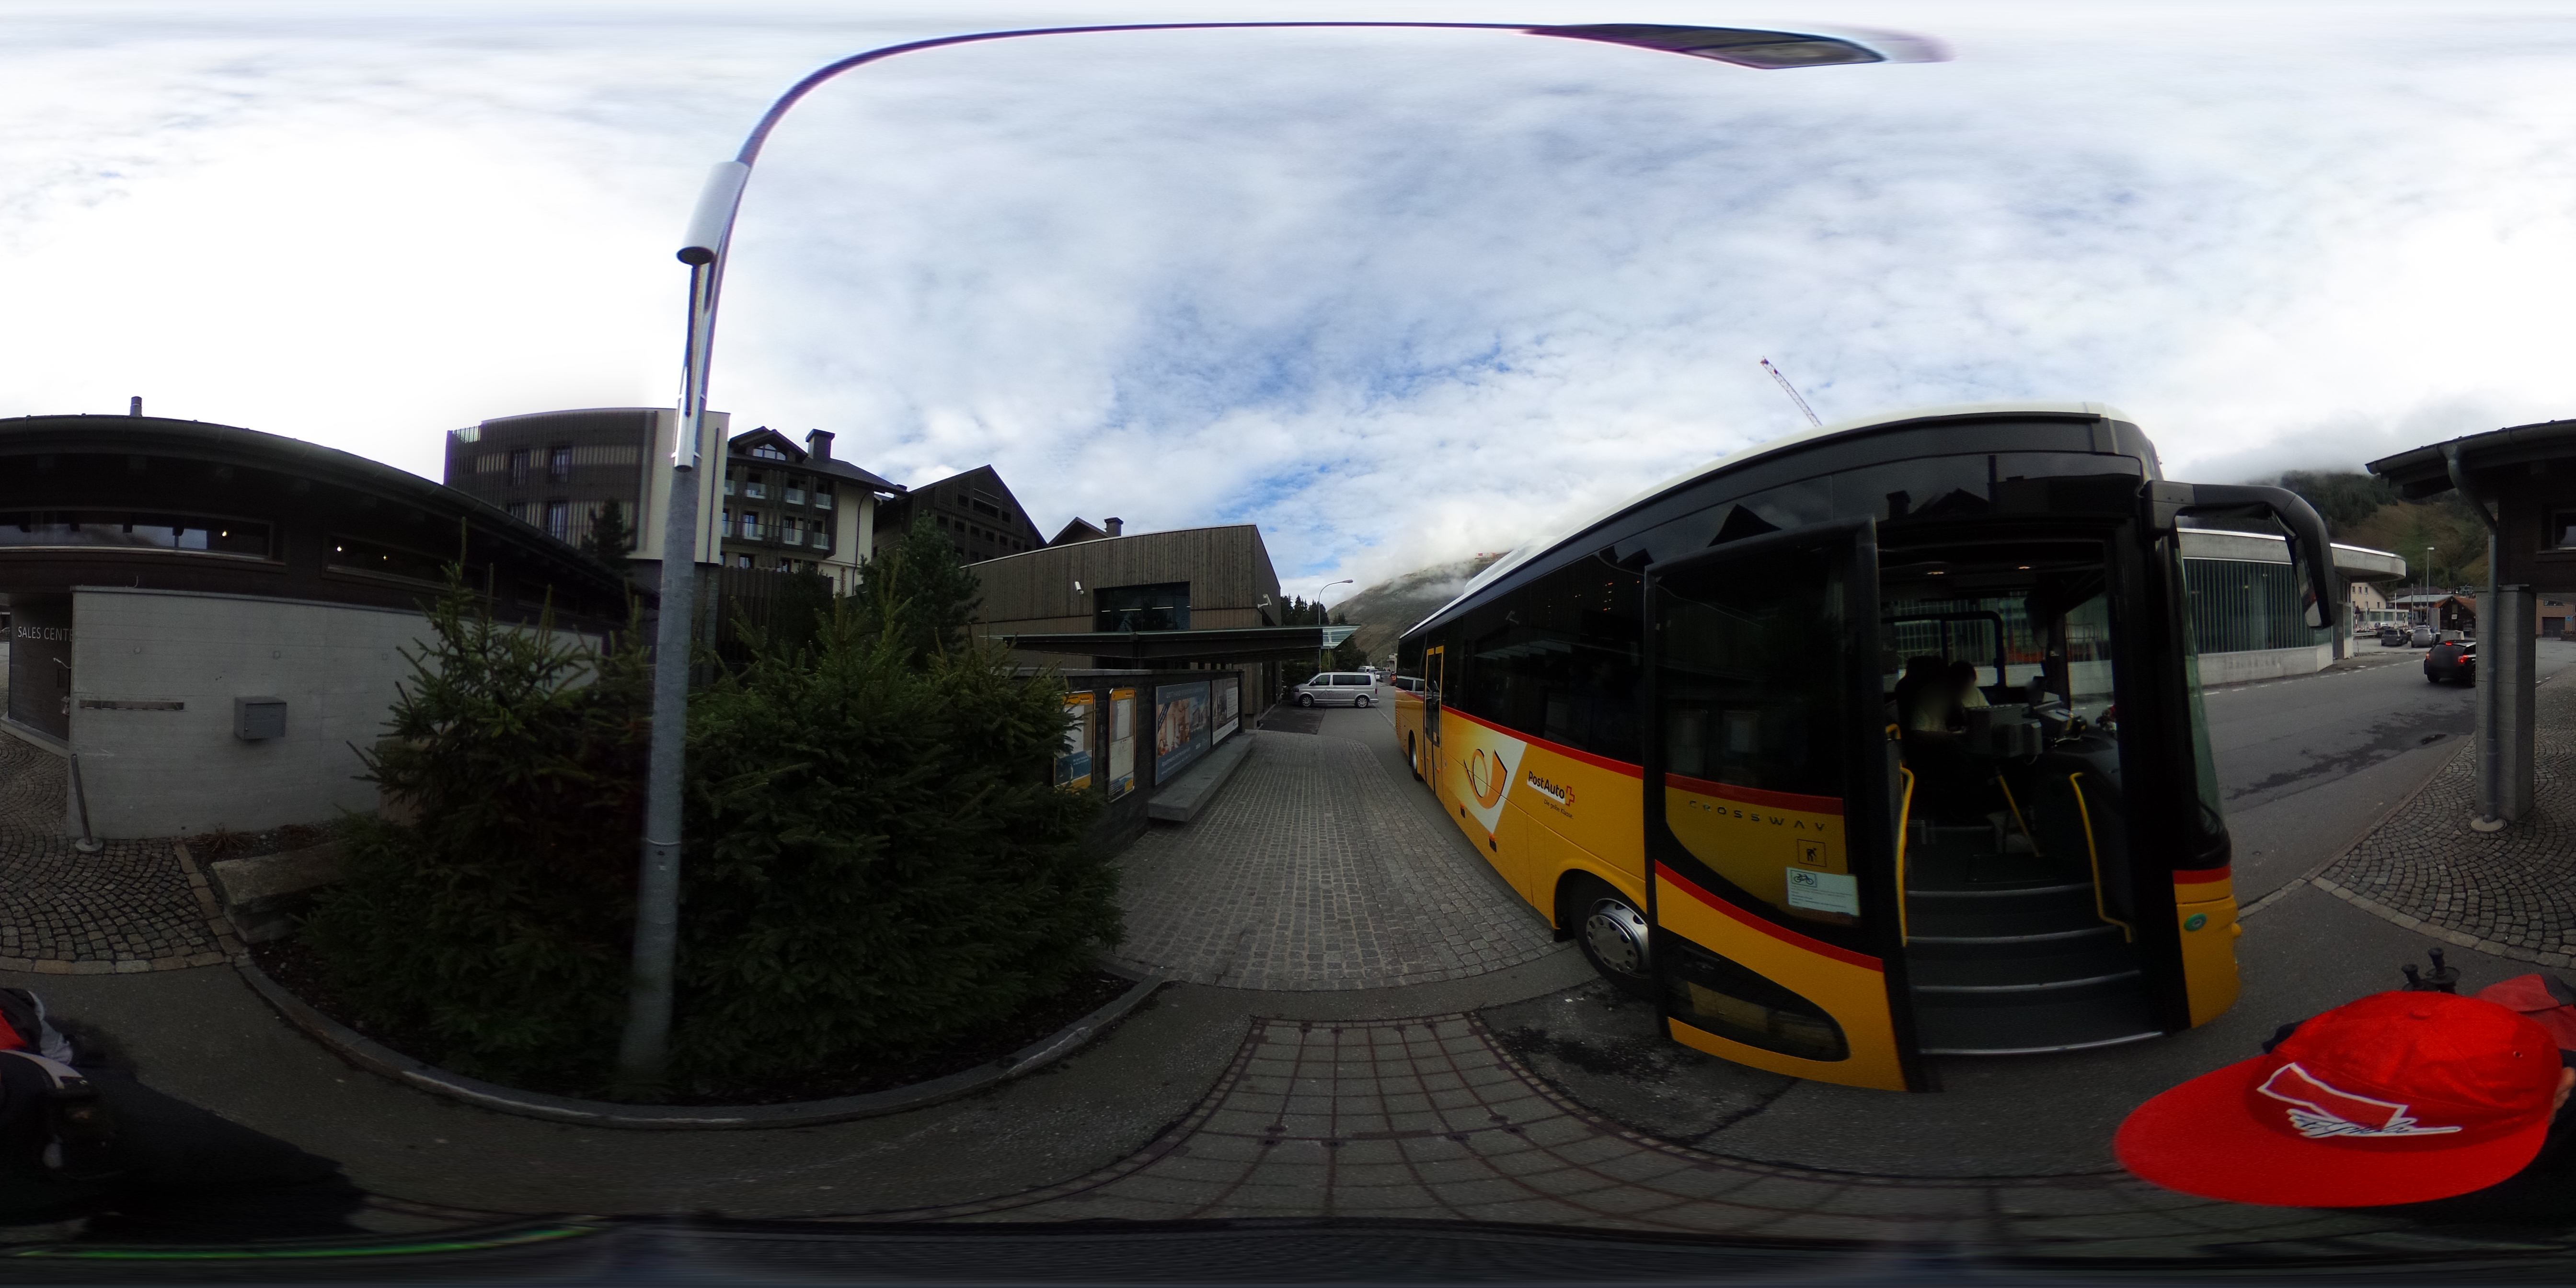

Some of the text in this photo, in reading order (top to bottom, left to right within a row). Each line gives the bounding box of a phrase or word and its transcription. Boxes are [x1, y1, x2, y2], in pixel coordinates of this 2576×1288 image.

[18, 626, 41, 639] SALES
[1528, 770, 1564, 799] PostAuto
[1689, 800, 1825, 831] CROSSWAY
